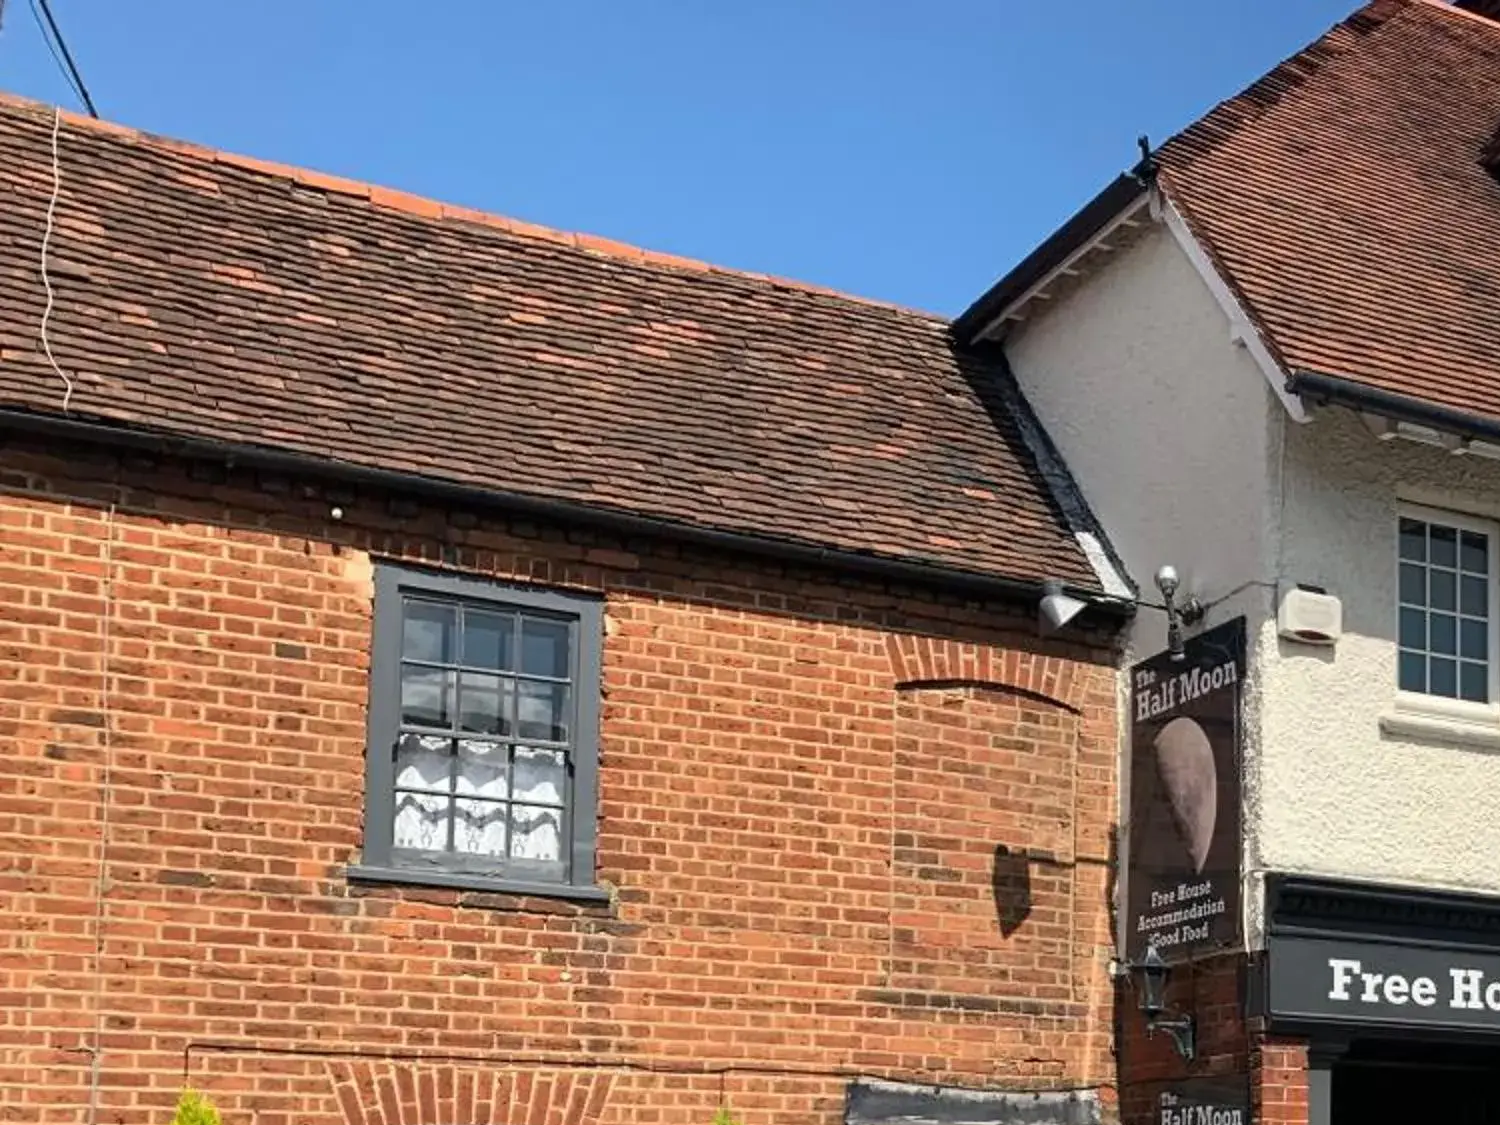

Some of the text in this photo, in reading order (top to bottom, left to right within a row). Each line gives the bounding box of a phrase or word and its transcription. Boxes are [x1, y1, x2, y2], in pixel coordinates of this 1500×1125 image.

[1136, 669, 1156, 689] The
[1136, 660, 1237, 722] Half Moon
[1149, 921, 1208, 949] Good Food
[1328, 957, 1437, 1006] Free
